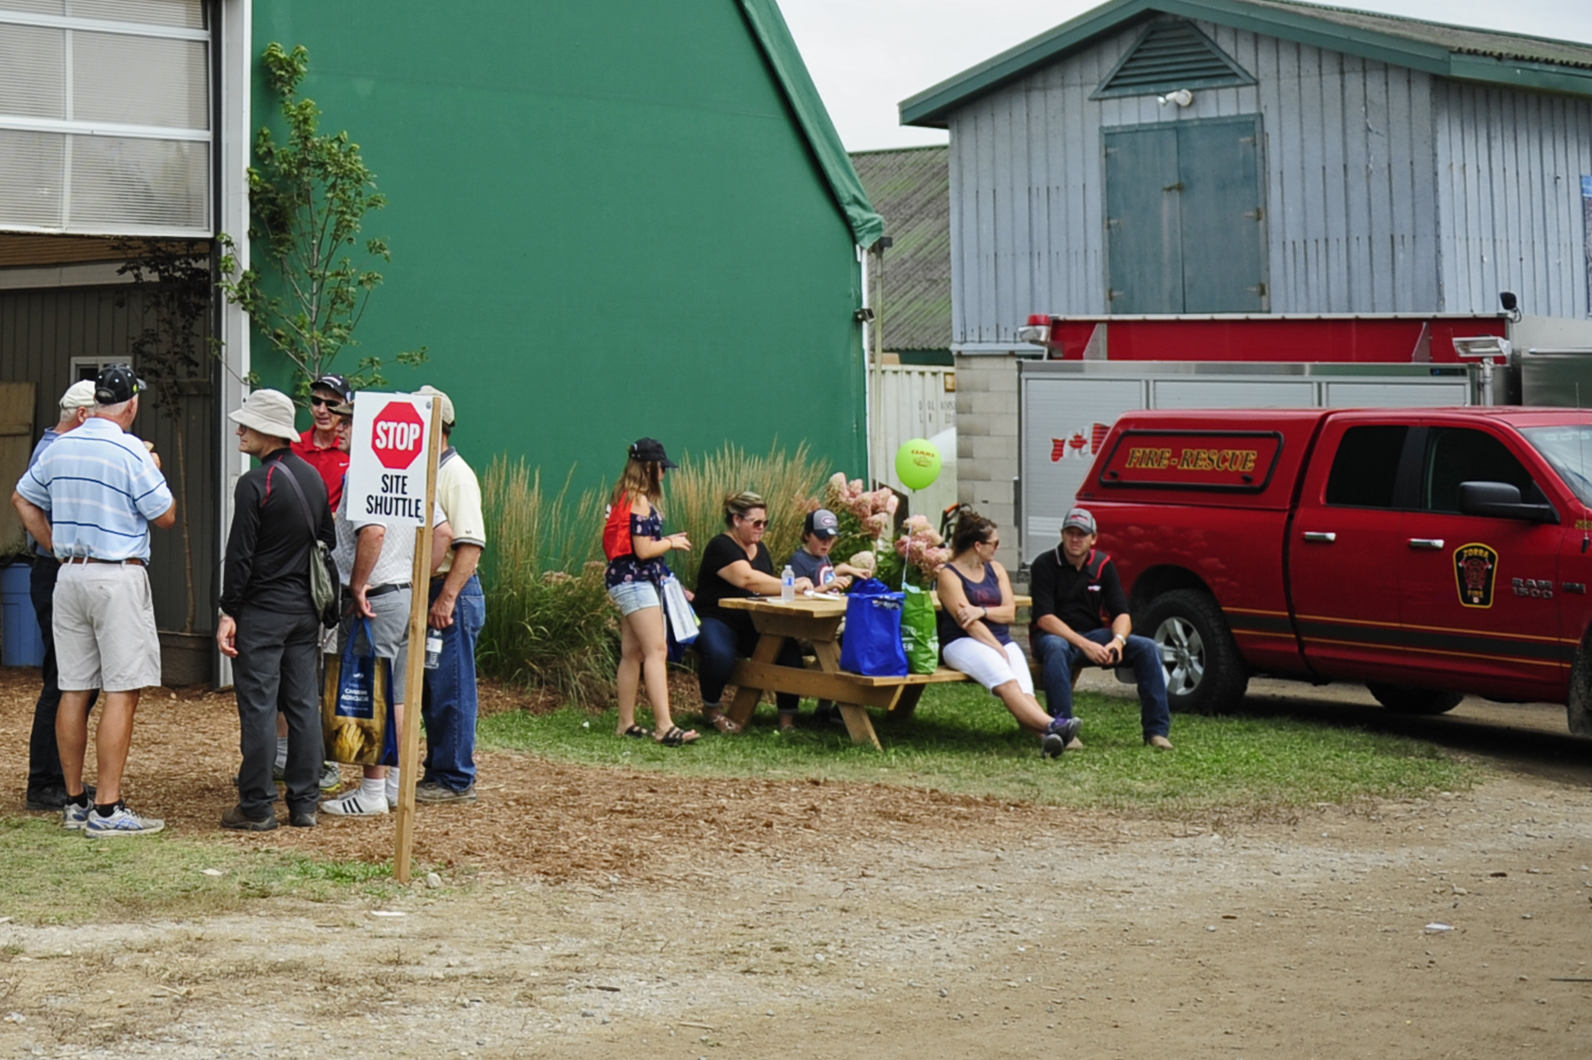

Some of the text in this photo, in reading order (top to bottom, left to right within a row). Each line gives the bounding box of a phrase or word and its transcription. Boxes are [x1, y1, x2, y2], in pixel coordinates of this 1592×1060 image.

[375, 420, 421, 451] STOP
[381, 473, 408, 495] SITE
[365, 494, 422, 518] SHUTTLE
[1512, 577, 1553, 589] RAM
[1512, 586, 1553, 599] 1500
